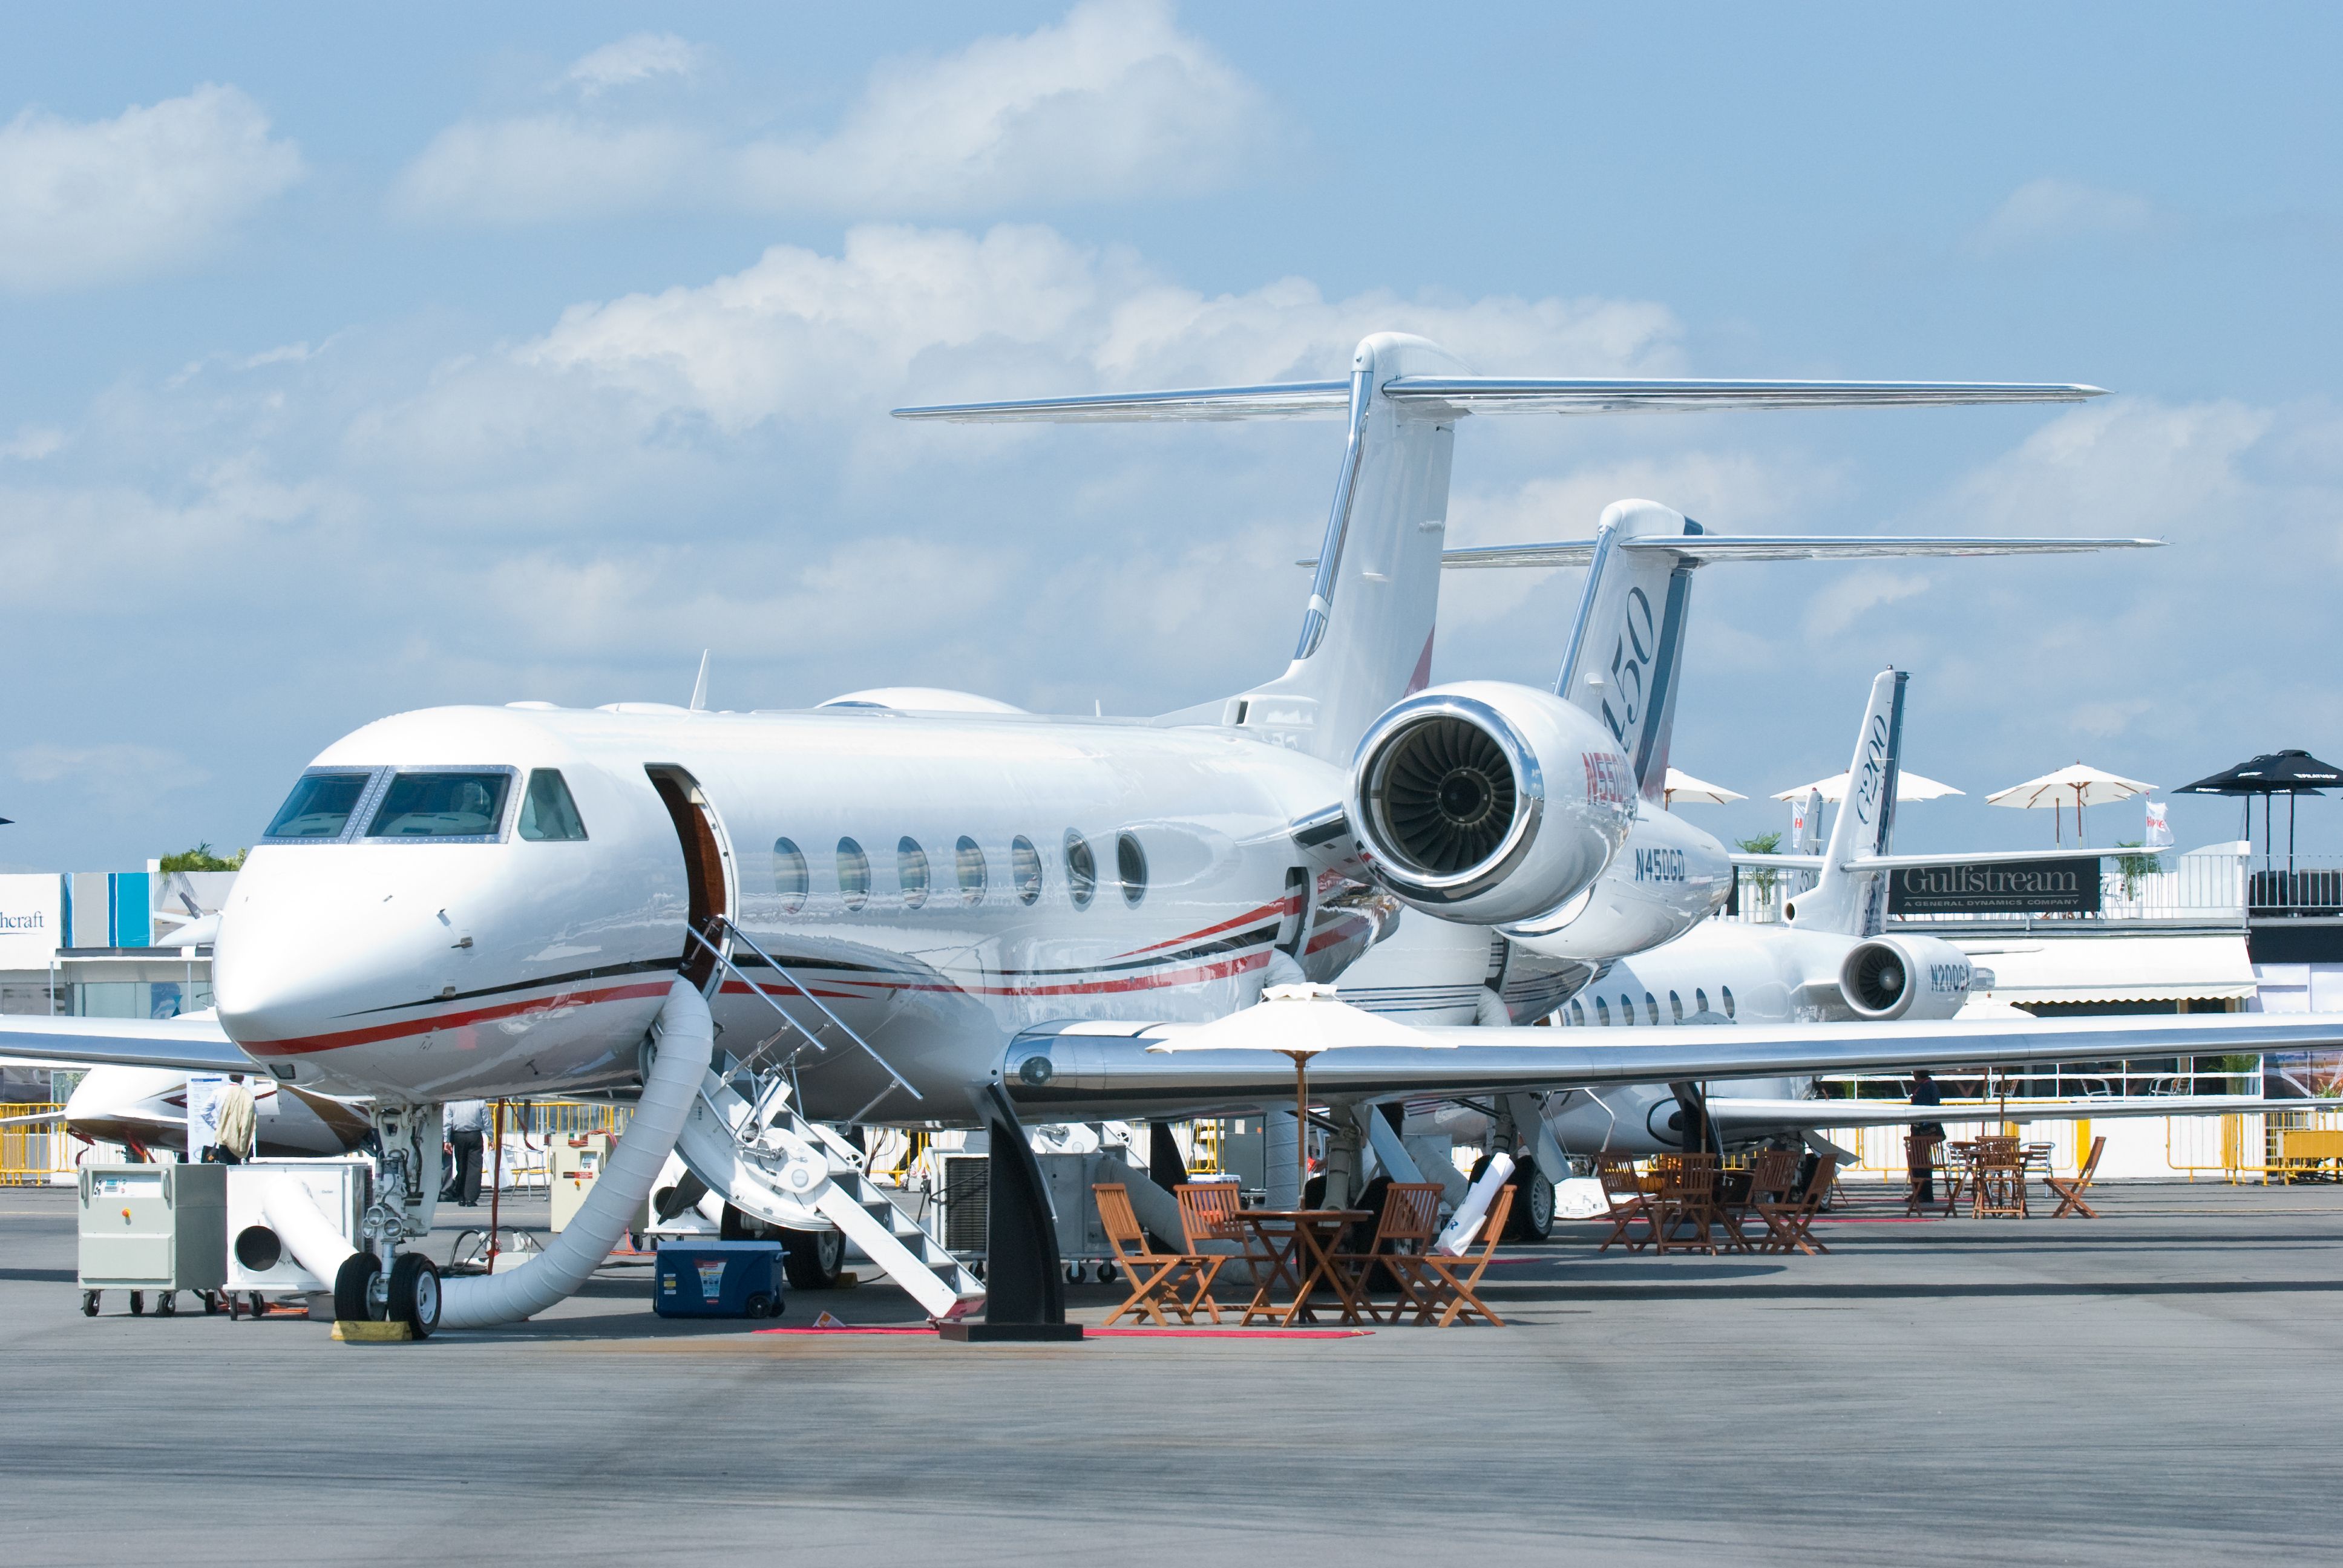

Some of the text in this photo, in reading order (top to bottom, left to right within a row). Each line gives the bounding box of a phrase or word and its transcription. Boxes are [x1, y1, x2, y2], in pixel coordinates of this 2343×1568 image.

[1856, 715, 1887, 825] G200
[1635, 848, 1685, 881] N450GD
[1904, 865, 2079, 893] Gulfstream
